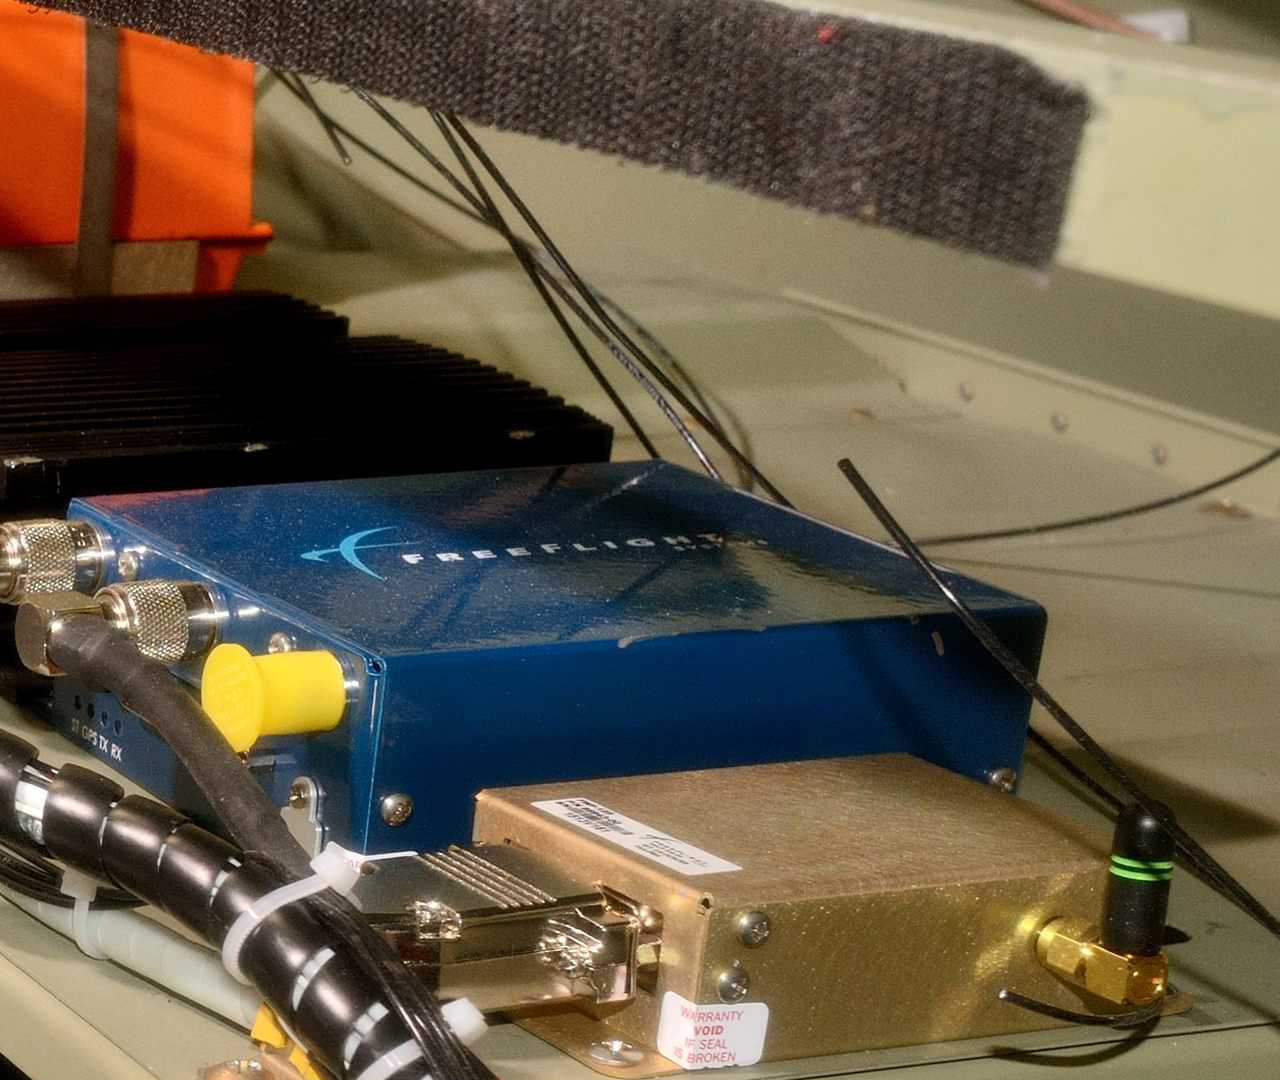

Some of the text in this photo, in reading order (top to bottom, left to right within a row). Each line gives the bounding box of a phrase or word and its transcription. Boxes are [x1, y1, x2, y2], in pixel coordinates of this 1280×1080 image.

[401, 533, 723, 564] FREEFLIGHT
[82, 725, 98, 746] GPS
[99, 734, 109, 753] TX
[111, 743, 122, 762] RX
[680, 1005, 744, 1023] WARRANTY
[694, 1025, 724, 1037] VOID
[684, 1037, 728, 1050] IF SEAL
[674, 1046, 737, 1064] IS BROKEN
